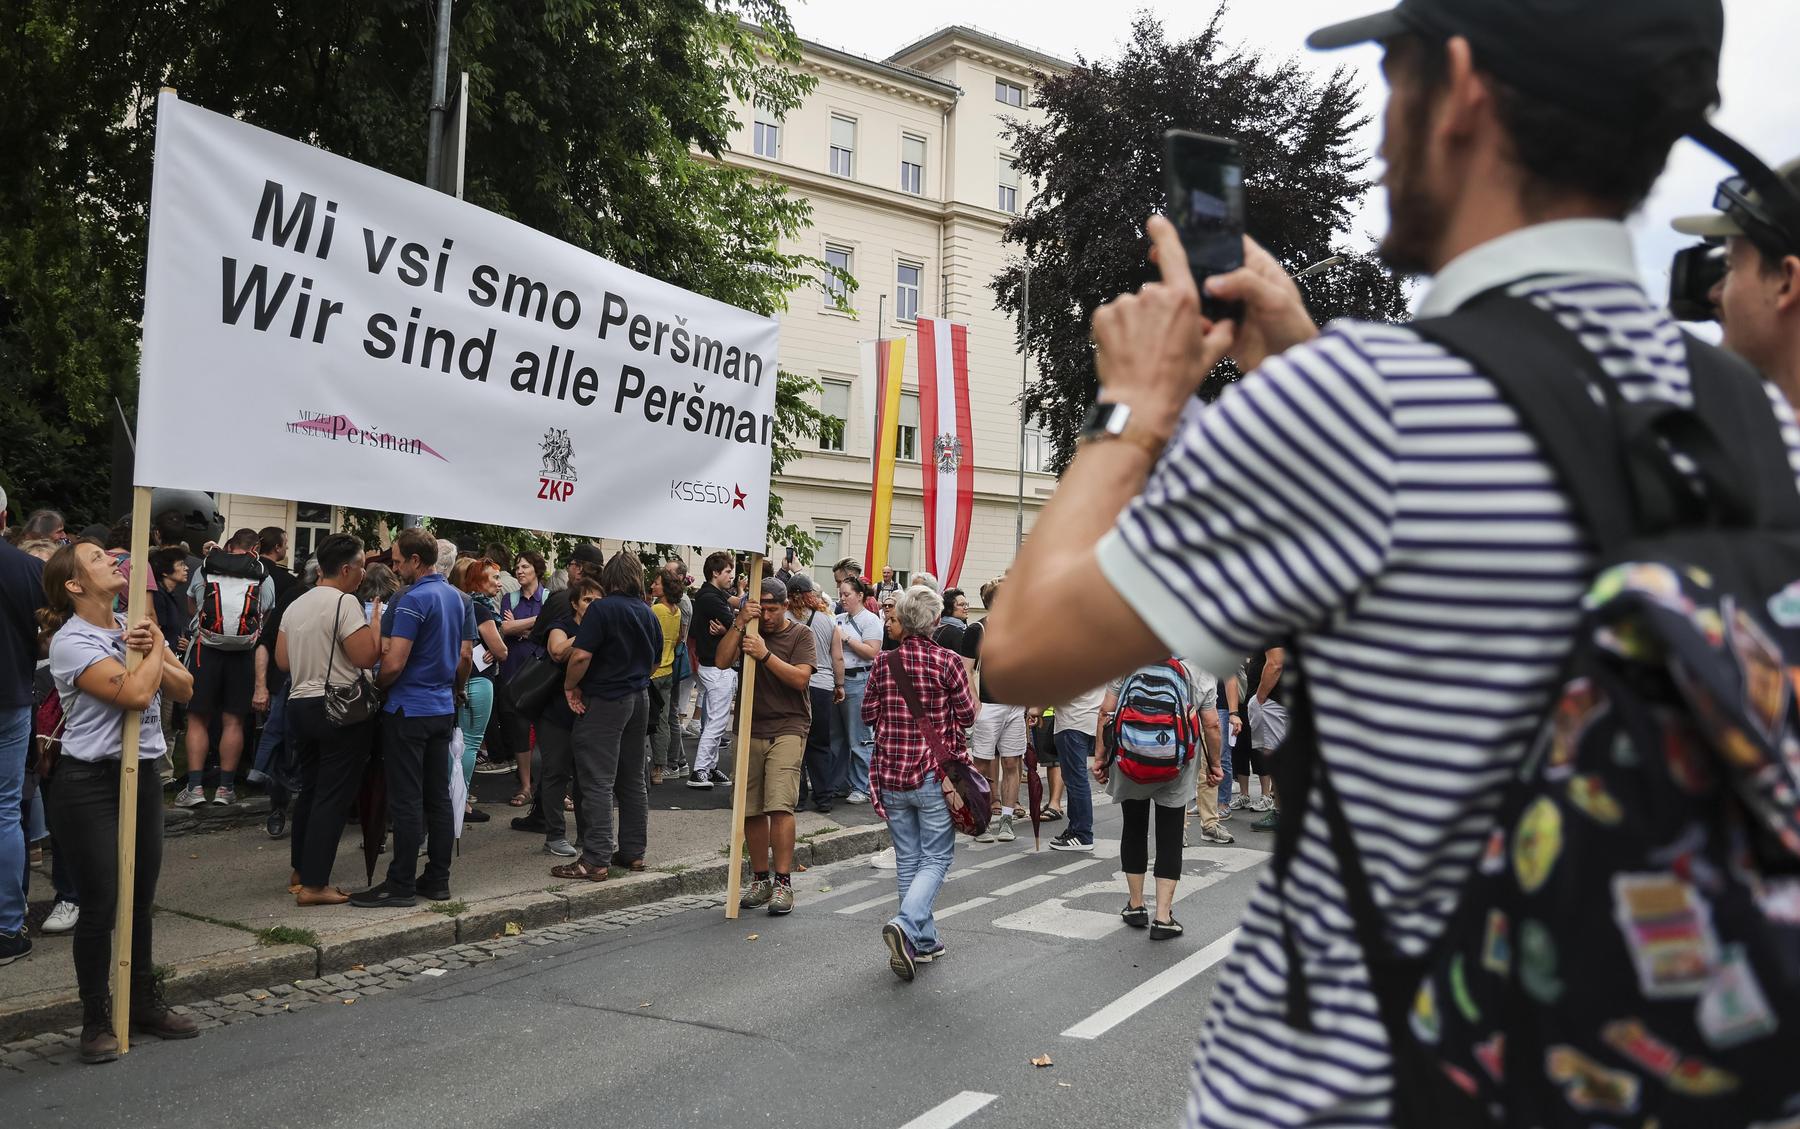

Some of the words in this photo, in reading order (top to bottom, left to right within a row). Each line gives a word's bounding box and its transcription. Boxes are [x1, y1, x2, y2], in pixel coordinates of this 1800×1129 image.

[252, 179, 338, 260] Mi
[363, 227, 454, 293] vsi
[468, 264, 581, 331] smo
[598, 291, 763, 387] Peršman
[222, 256, 344, 344] Wir
[363, 307, 498, 382] sind
[510, 345, 599, 406] alle
[614, 364, 775, 446] Peršman
[299, 409, 332, 425] MUZEJ
[286, 422, 333, 440] MUSEUM
[331, 415, 423, 455] Peršman
[537, 477, 575, 502] ZKP
[671, 479, 731, 505] KSŠŠD
